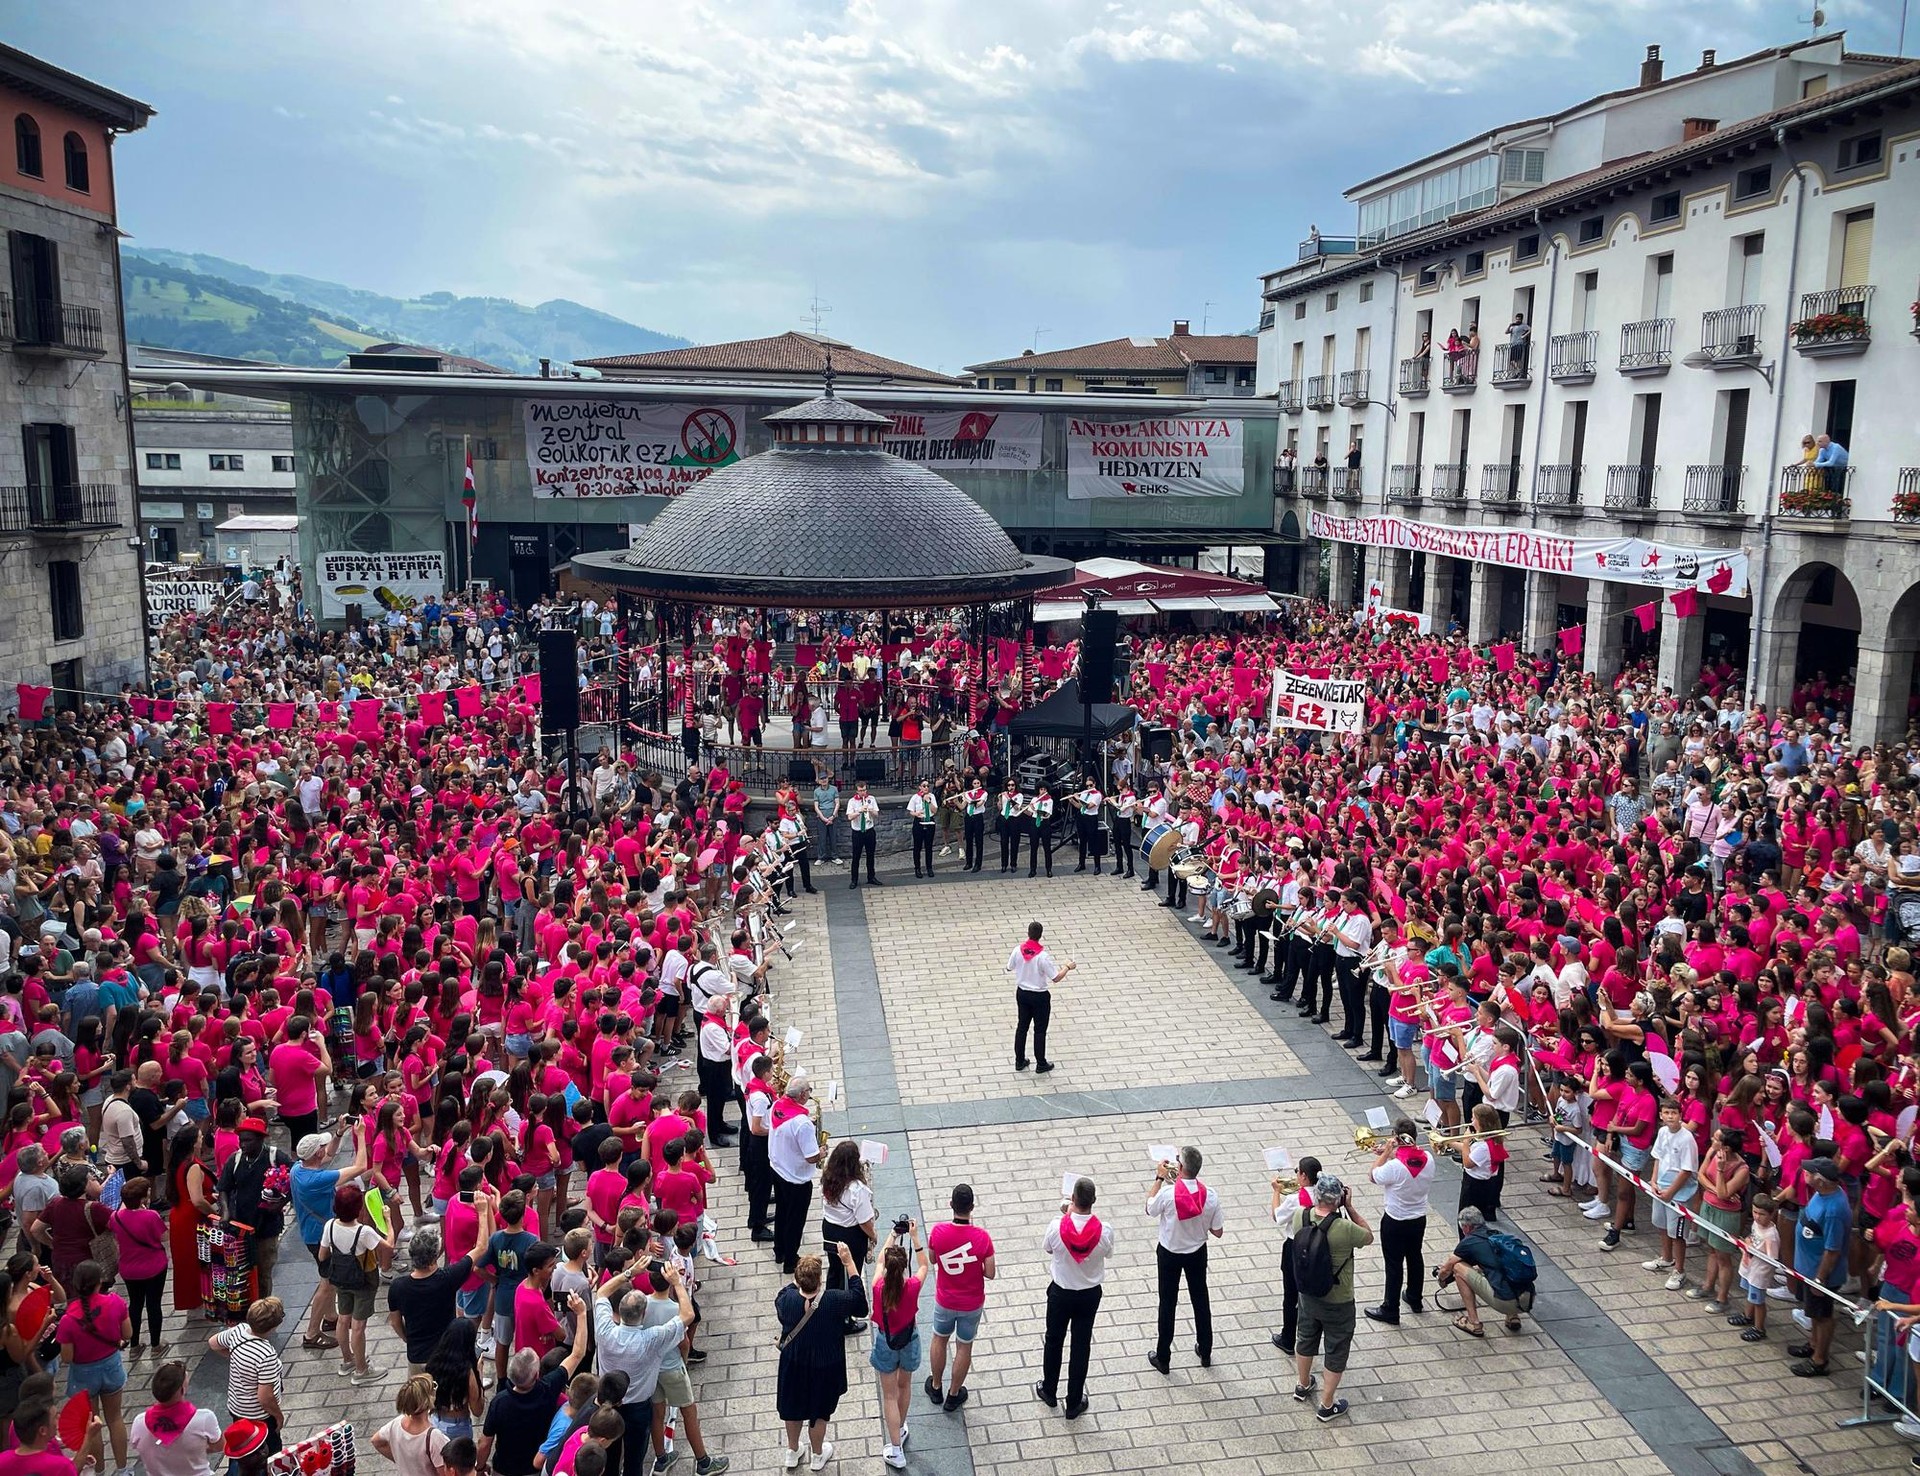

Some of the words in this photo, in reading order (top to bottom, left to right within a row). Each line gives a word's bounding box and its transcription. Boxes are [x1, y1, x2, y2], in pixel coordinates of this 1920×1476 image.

[1069, 419, 1231, 437] ANTOLAKUNTZA
[1092, 441, 1209, 457] KOMUNISTA
[1099, 461, 1202, 478] HEDATZEN
[1140, 482, 1169, 494] EHKS
[1312, 511, 1353, 539] EUSKAL
[1354, 517, 1408, 546] ESTATU
[1410, 523, 1501, 562] SOZIALISTA
[1505, 532, 1575, 572] ERAIKI
[325, 562, 385, 572] EUSKAL
[388, 561, 442, 571] HERRIA
